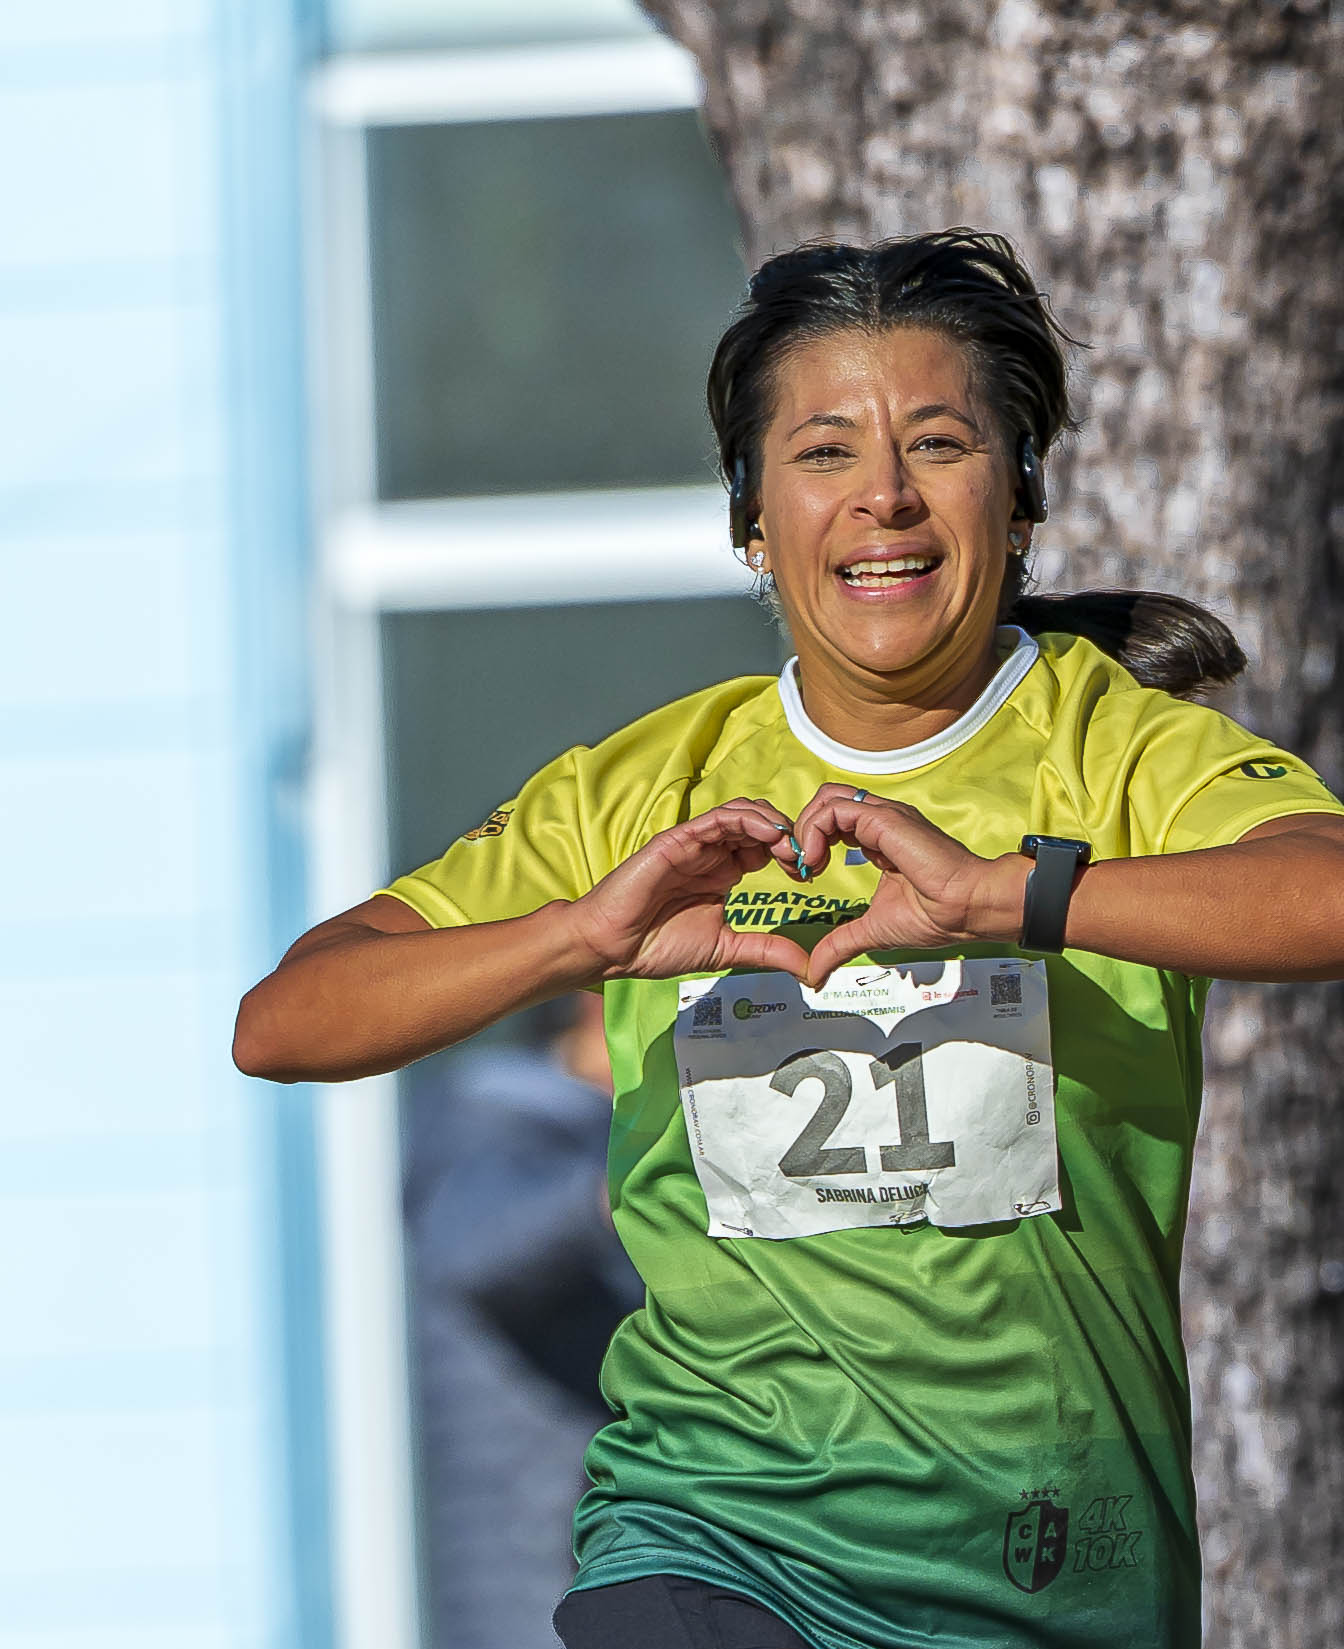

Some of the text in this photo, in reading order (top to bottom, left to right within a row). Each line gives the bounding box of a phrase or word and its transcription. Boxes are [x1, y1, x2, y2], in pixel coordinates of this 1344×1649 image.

[726, 891, 850, 910] ARATÓN
[769, 1041, 956, 1177] 21
[816, 1187, 877, 1204] SABRINA
[1078, 1495, 1133, 1535] 4K
[1073, 1531, 1143, 1573] 10K
